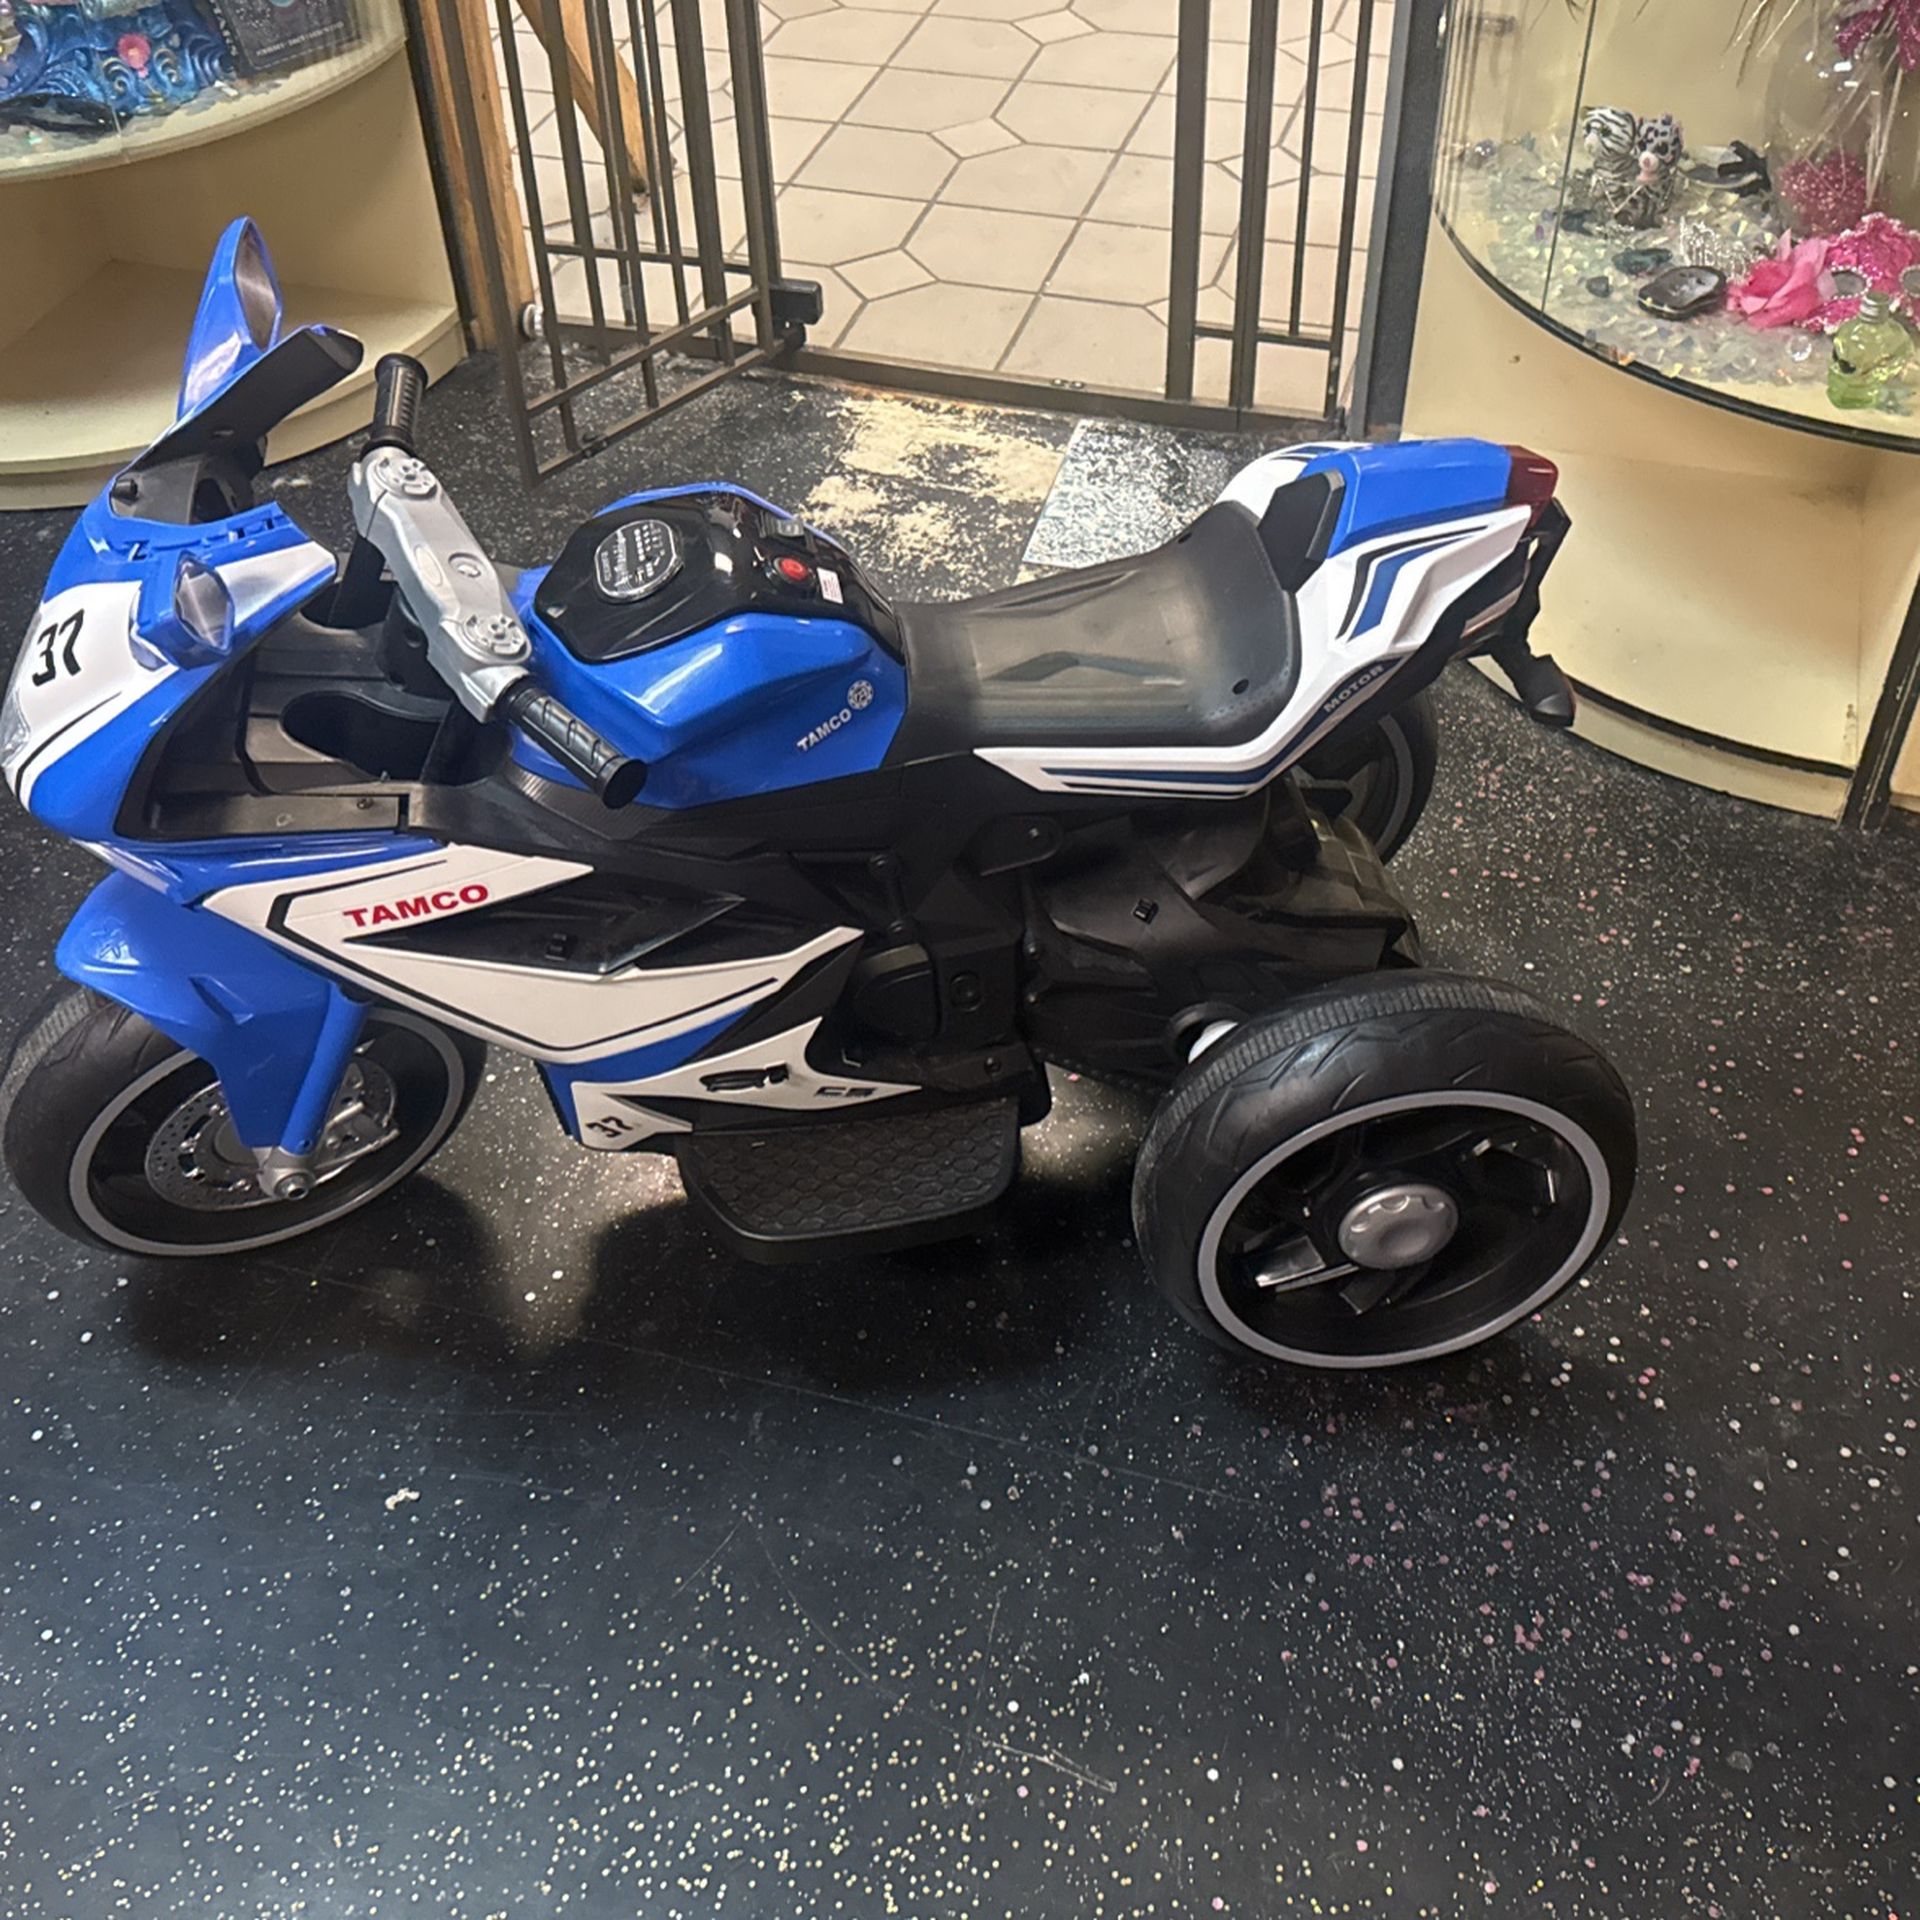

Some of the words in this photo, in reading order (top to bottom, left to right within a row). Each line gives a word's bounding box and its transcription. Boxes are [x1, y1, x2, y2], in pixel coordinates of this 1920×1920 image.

[32, 608, 85, 687] 37
[1323, 664, 1384, 713] MOTOR
[796, 708, 852, 751] TAMCO
[342, 884, 489, 927] TAMCO
